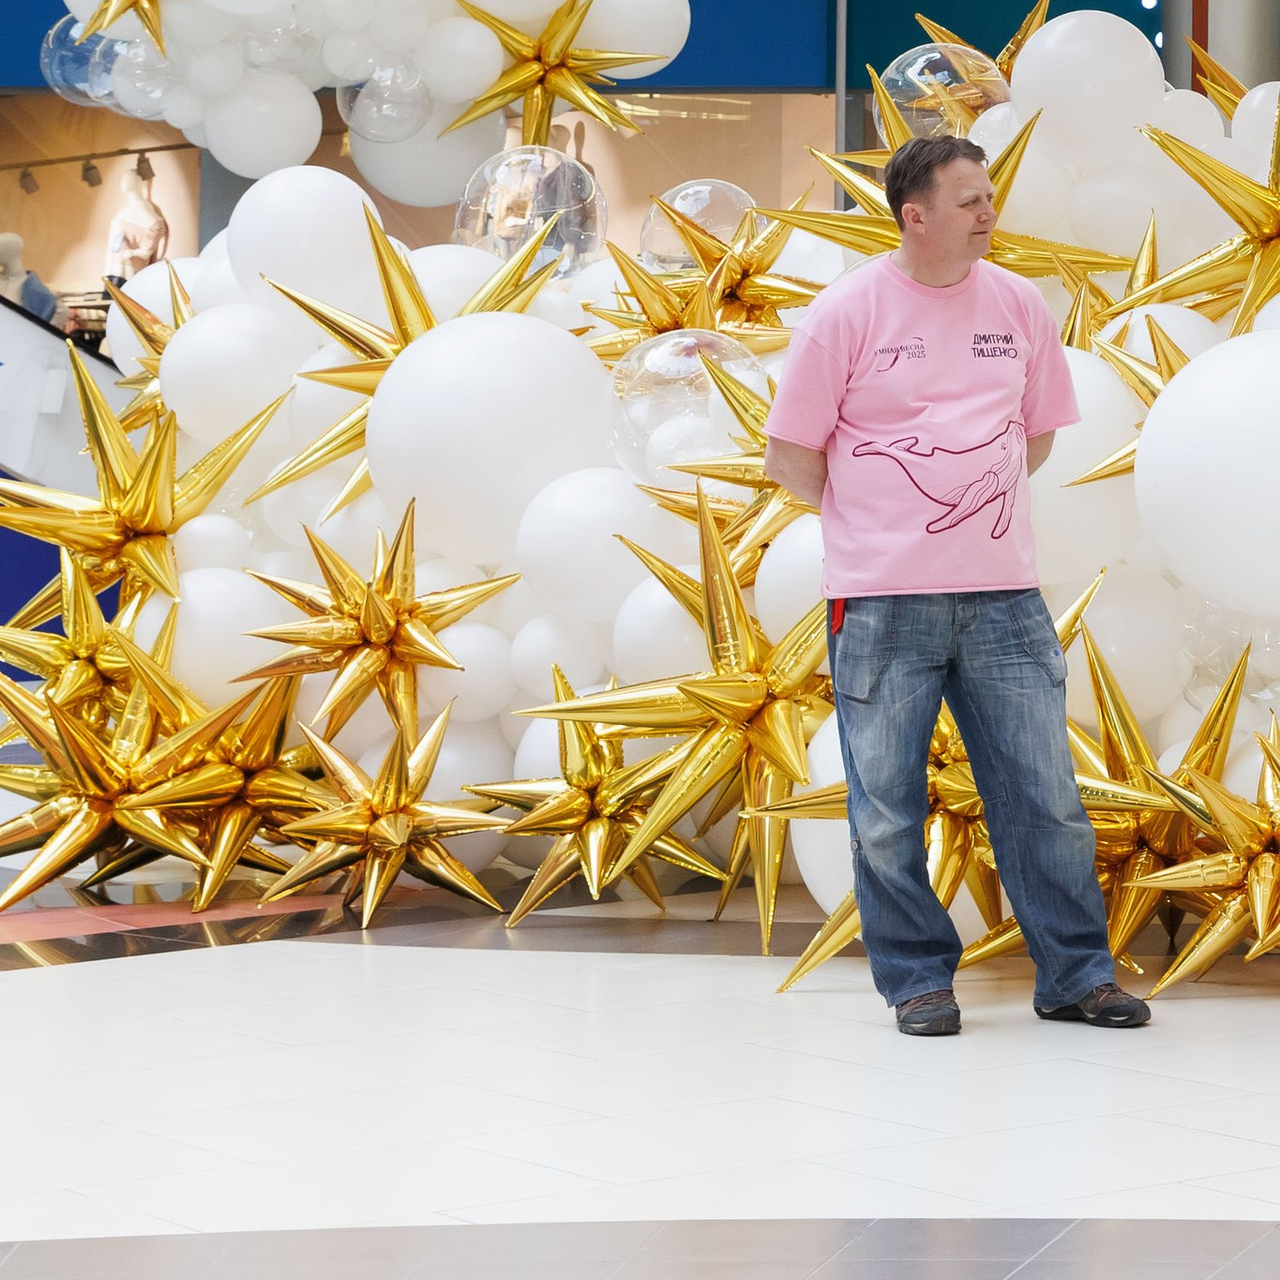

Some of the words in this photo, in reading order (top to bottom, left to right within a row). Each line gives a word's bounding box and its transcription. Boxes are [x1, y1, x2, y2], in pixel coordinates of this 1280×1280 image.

[973, 333, 1014, 345] ДМИТРИЙ
[873, 347, 899, 357] УМНАЯ
[900, 343, 925, 353] ВЕСНА
[906, 350, 927, 360] 2025
[971, 347, 1018, 359] ТИЩЕНКО
